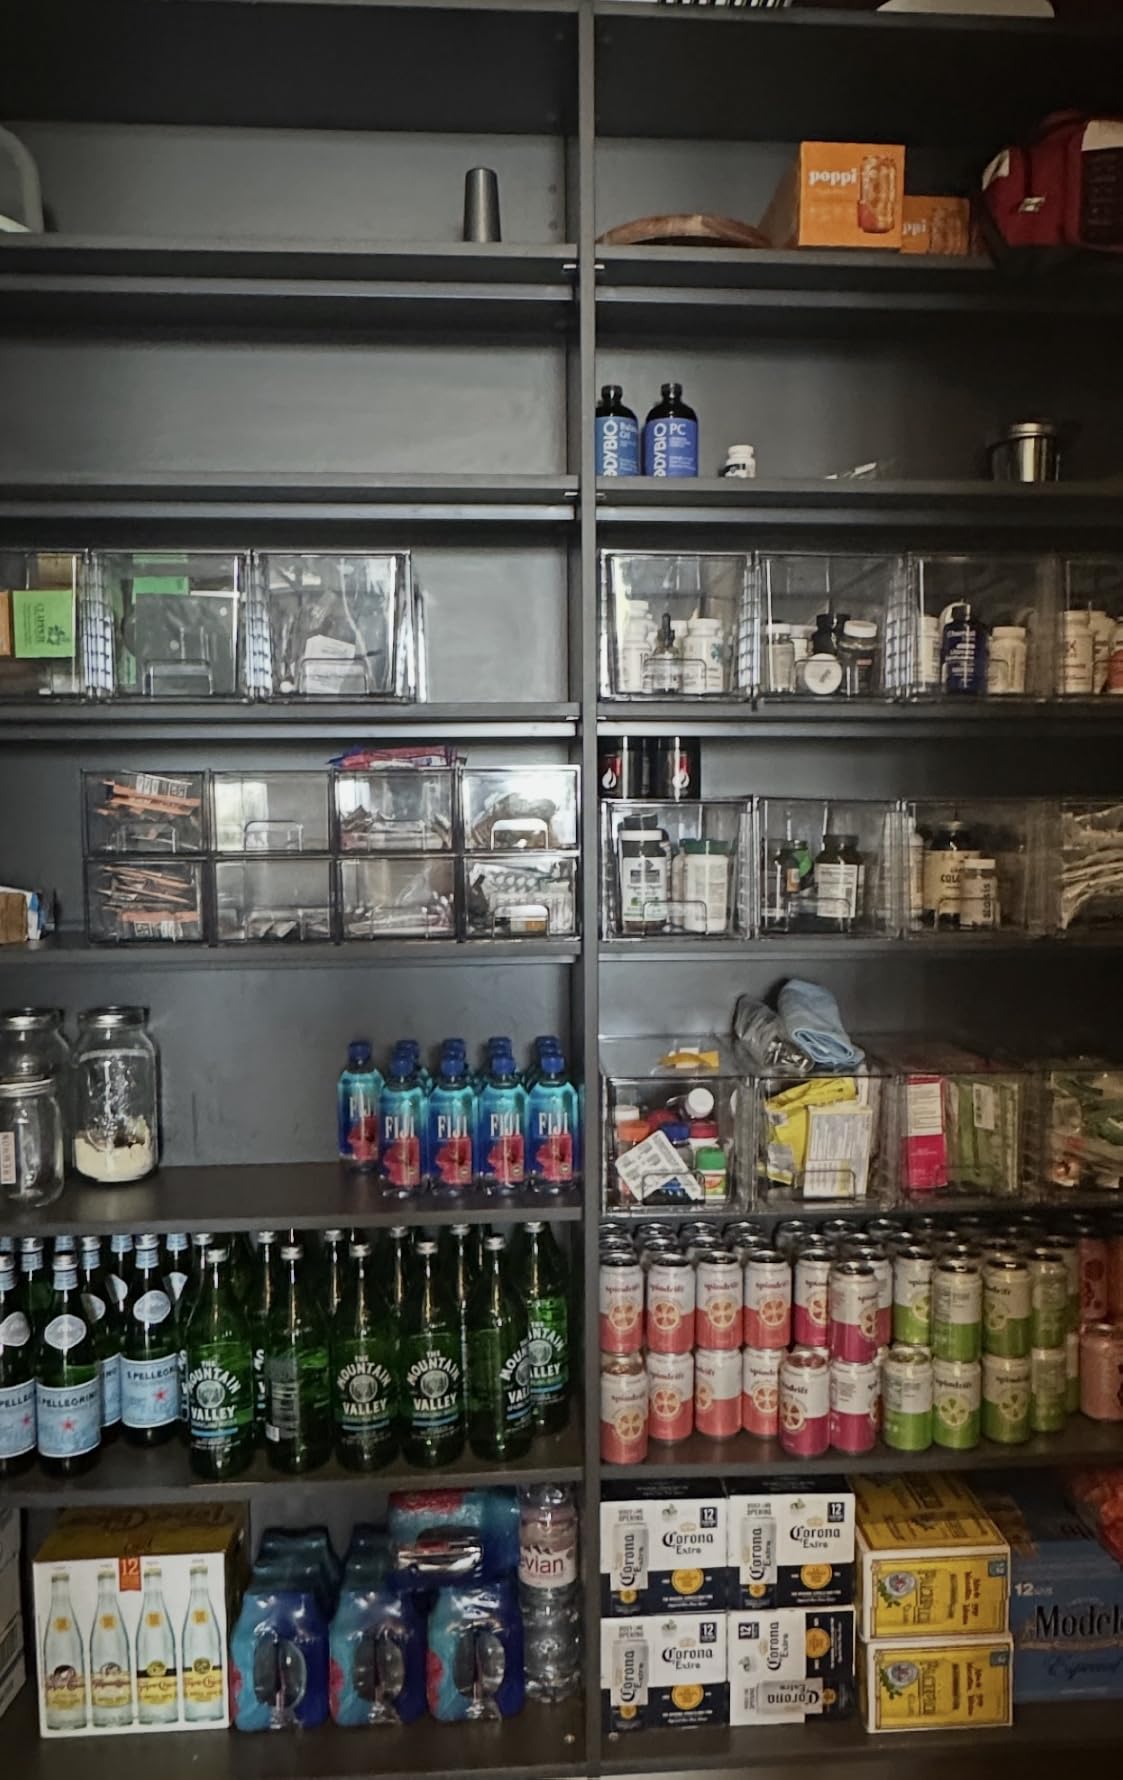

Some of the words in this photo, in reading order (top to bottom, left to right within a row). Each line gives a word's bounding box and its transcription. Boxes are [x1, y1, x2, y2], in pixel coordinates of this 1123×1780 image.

[808, 167, 858, 186] poppi
[902, 219, 926, 236] ppi
[669, 423, 686, 435] PC
[385, 1116, 415, 1138] FIJI
[437, 1115, 467, 1138] FIJI
[490, 1113, 520, 1137] FIJI
[538, 1112, 568, 1136] FIJI
[337, 1361, 392, 1391] MOUNTAIN
[407, 1356, 460, 1386] MOUNTAIN
[342, 1398, 388, 1415] VALLEY
[413, 1392, 458, 1411] VALLEY
[191, 1406, 236, 1421] VALLEY
[703, 1508, 714, 1520] 12
[831, 1503, 842, 1515] 12
[662, 1531, 714, 1548] Corona
[790, 1525, 841, 1542] Corona
[676, 1545, 702, 1555] Extra
[802, 1540, 828, 1549] Extra
[620, 1533, 635, 1587] Corona
[749, 1527, 765, 1581] Corona
[120, 1558, 139, 1576] 12
[1015, 1583, 1034, 1596] 12
[703, 1623, 714, 1635] 12
[740, 1625, 752, 1637] 12
[767, 1621, 782, 1671] Corona
[662, 1647, 713, 1664] Corona
[675, 1660, 701, 1671] Extra
[620, 1650, 635, 1703] Corona
[768, 1689, 820, 1705] Corona
